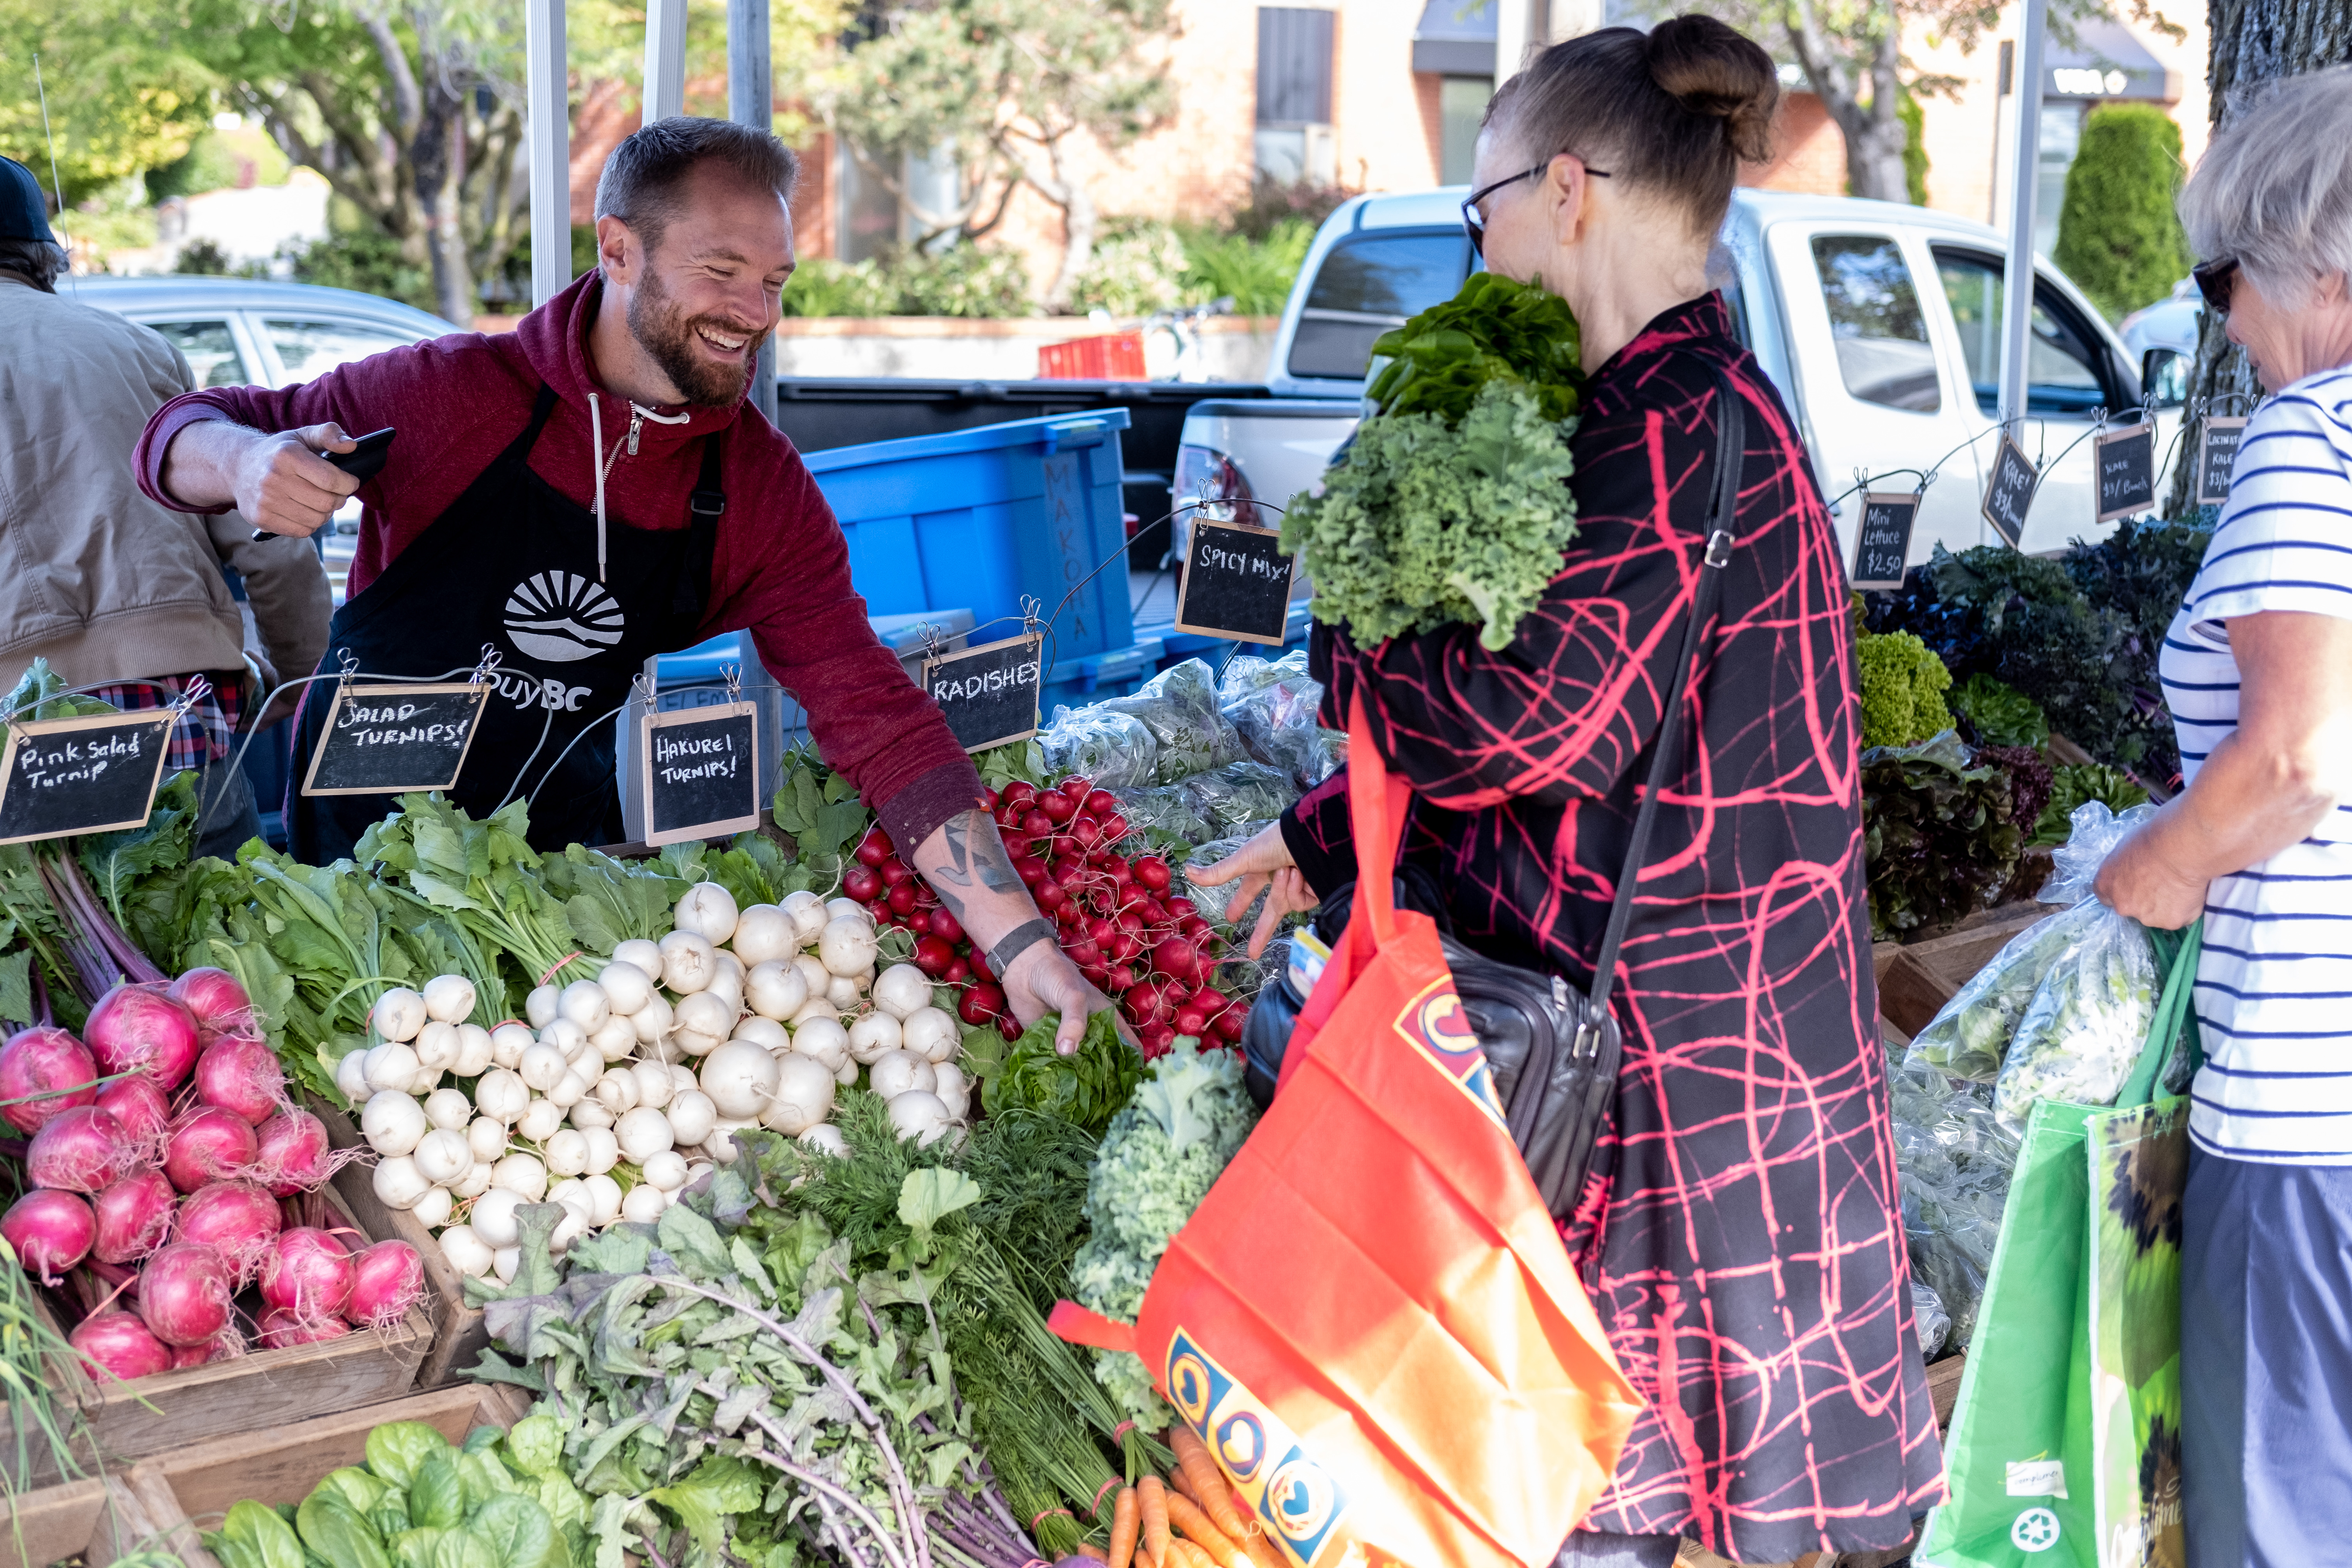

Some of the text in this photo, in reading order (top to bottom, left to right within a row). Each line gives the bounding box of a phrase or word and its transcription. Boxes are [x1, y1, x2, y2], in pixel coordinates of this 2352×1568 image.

[2212, 452, 2233, 466] KALE
[1867, 507, 1891, 526] Mini
[1865, 529, 1900, 546] Lettuce
[1200, 545, 1246, 576] SPICY
[1867, 548, 1901, 575] $2.50
[338, 704, 415, 728] SALAD
[21, 732, 140, 769] Pink Salad
[657, 734, 732, 764] HAKUREI
[661, 755, 736, 784] TURNIPS!
